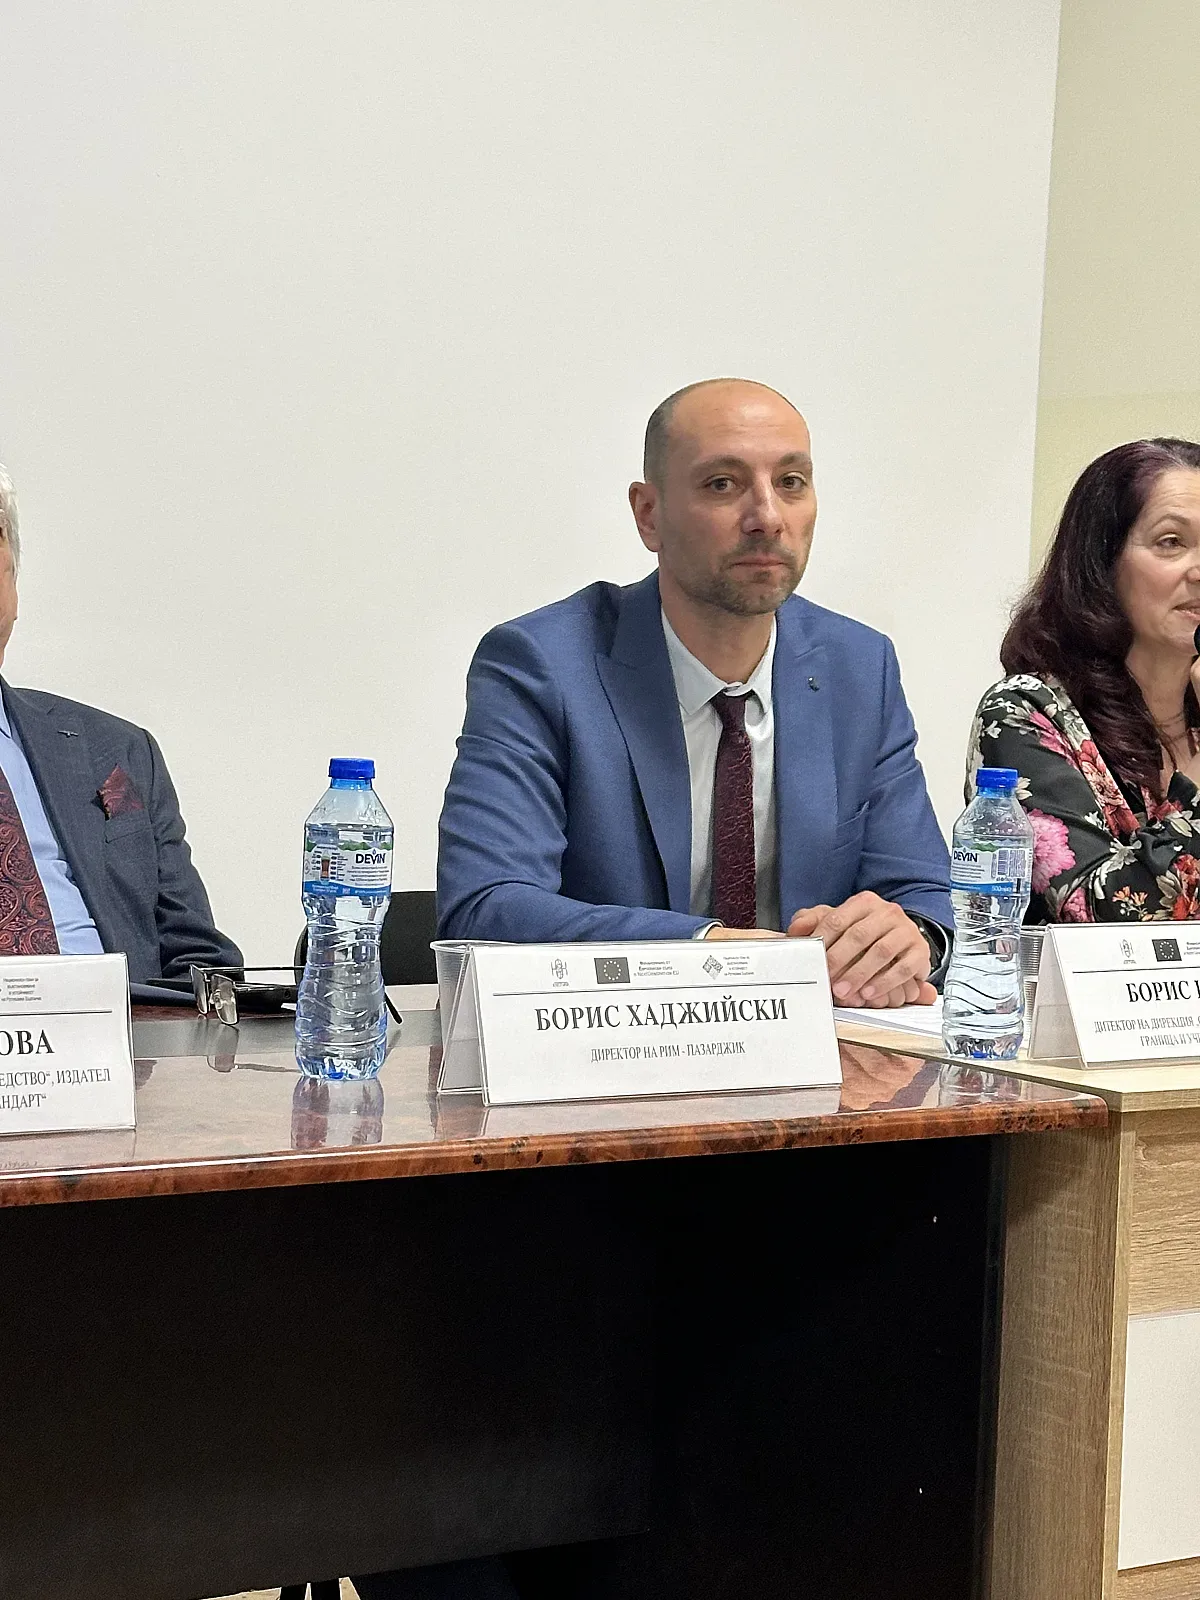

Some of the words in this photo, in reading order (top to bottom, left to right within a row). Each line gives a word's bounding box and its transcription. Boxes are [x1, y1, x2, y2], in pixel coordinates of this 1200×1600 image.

[355, 852, 387, 865] DEVIN
[954, 850, 978, 863] DEVIN
[1126, 980, 1192, 1003] БОРИС
[534, 1005, 621, 1031] БОРИС
[626, 995, 788, 1030] ХАДЖИЙСКИ
[0, 1029, 55, 1056] ОВА
[591, 1046, 642, 1063] ДИРЕКТОР
[643, 1046, 659, 1059] НА
[659, 1044, 681, 1058] РИМ
[686, 1041, 746, 1057] ПАЗАРДЖИК
[56, 1068, 112, 1086] ИЗДАТЕЛ
[0, 1093, 47, 1111] НДАРТ“
